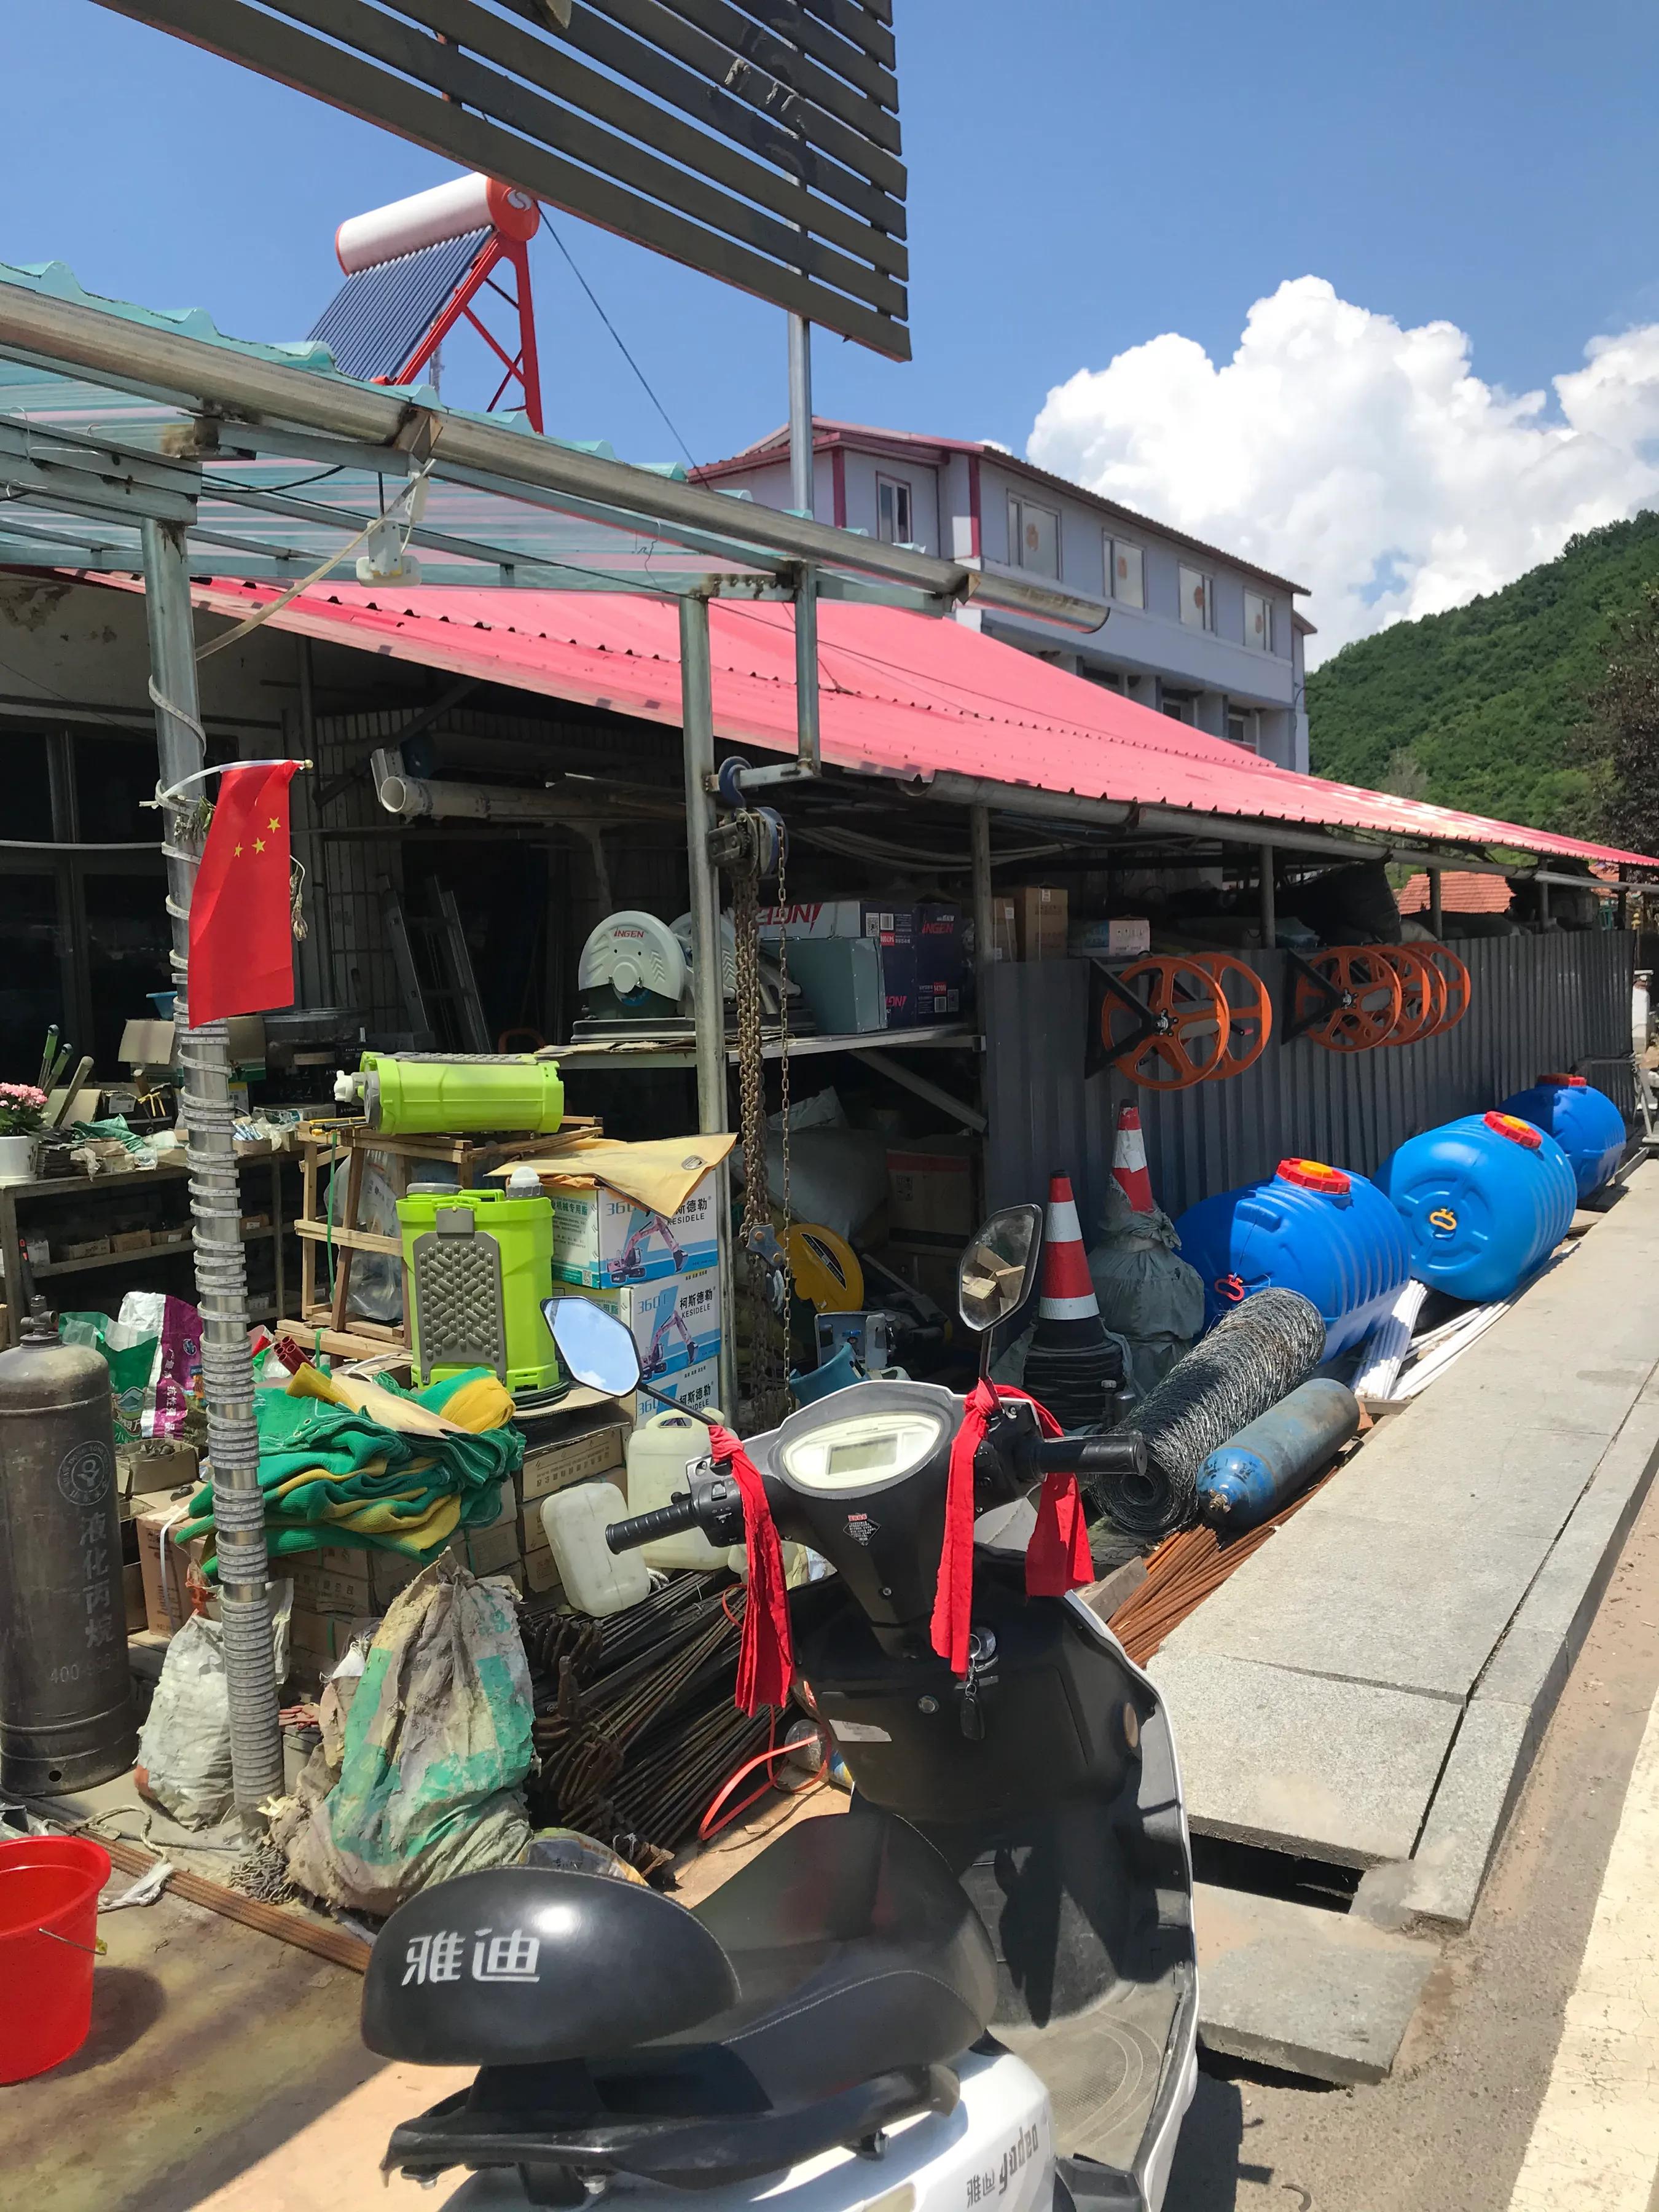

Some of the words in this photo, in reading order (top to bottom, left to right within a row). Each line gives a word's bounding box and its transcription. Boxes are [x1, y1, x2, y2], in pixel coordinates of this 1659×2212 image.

[614, 927, 644, 938] INGEN
[675, 1198, 708, 1215] 斯德勒
[680, 1288, 713, 1310] 柯斯德勒
[681, 1303, 710, 1319] KESIDELE
[680, 1384, 711, 1405] 柯斯德勒
[79, 1512, 114, 1649] 液化丙烷
[401, 1928, 541, 1986] 雅迪
[967, 2167, 995, 2208] 雅迪
